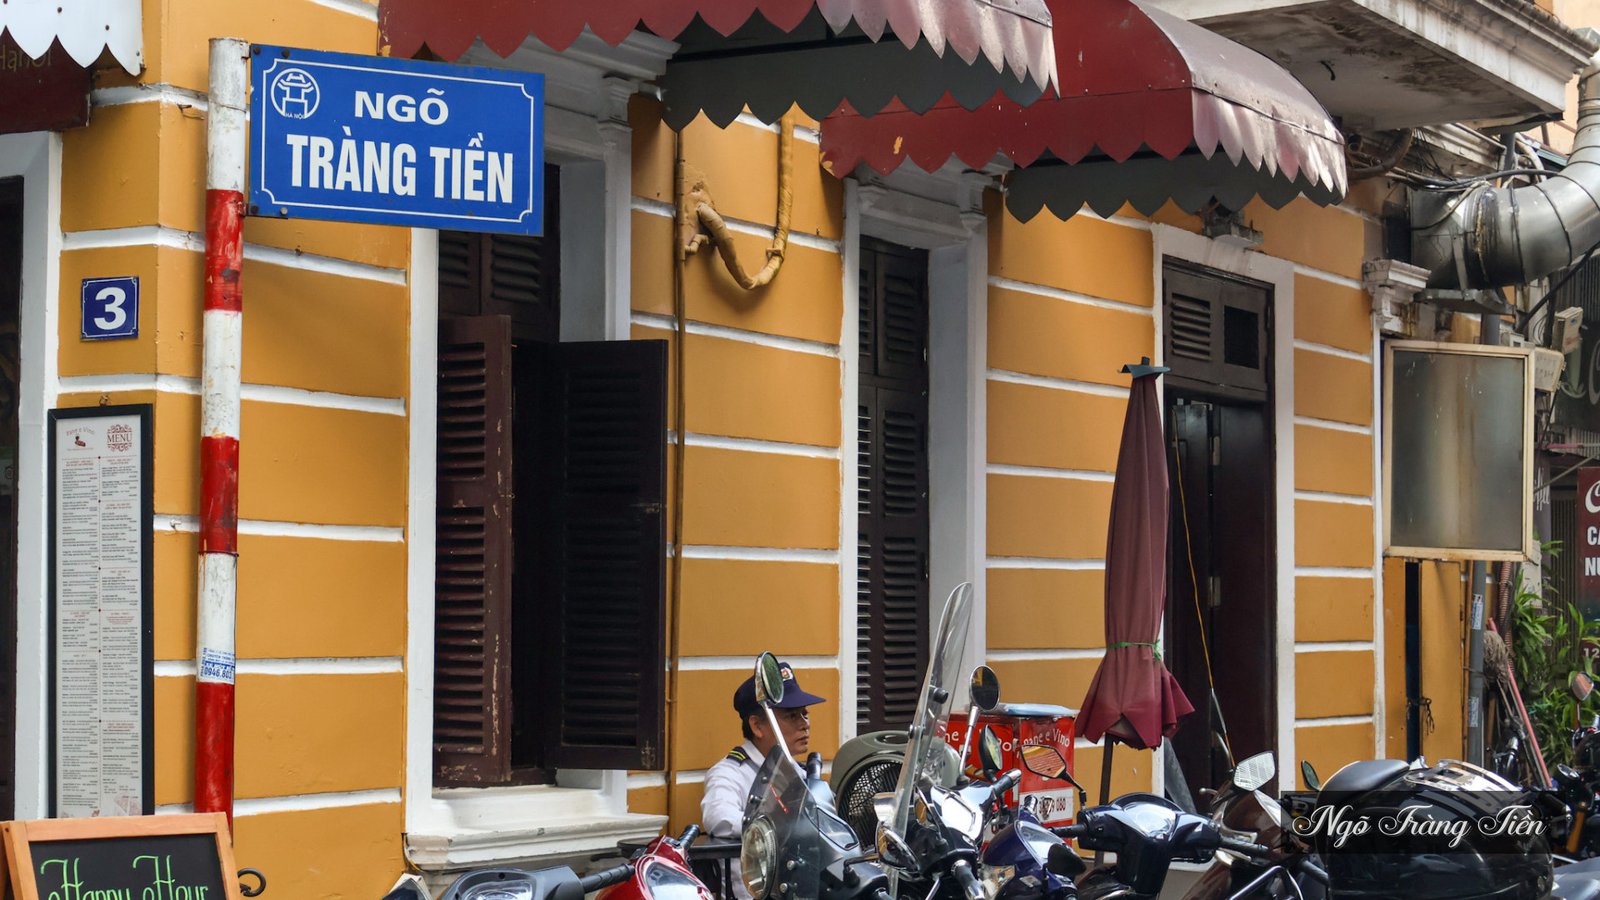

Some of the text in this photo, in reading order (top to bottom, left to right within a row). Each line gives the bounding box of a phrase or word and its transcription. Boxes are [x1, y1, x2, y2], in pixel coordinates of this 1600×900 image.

[354, 87, 450, 126] NGÕ
[286, 125, 514, 204] TRÀNG TIỀN
[94, 286, 126, 330] 3
[107, 433, 132, 443] MENU
